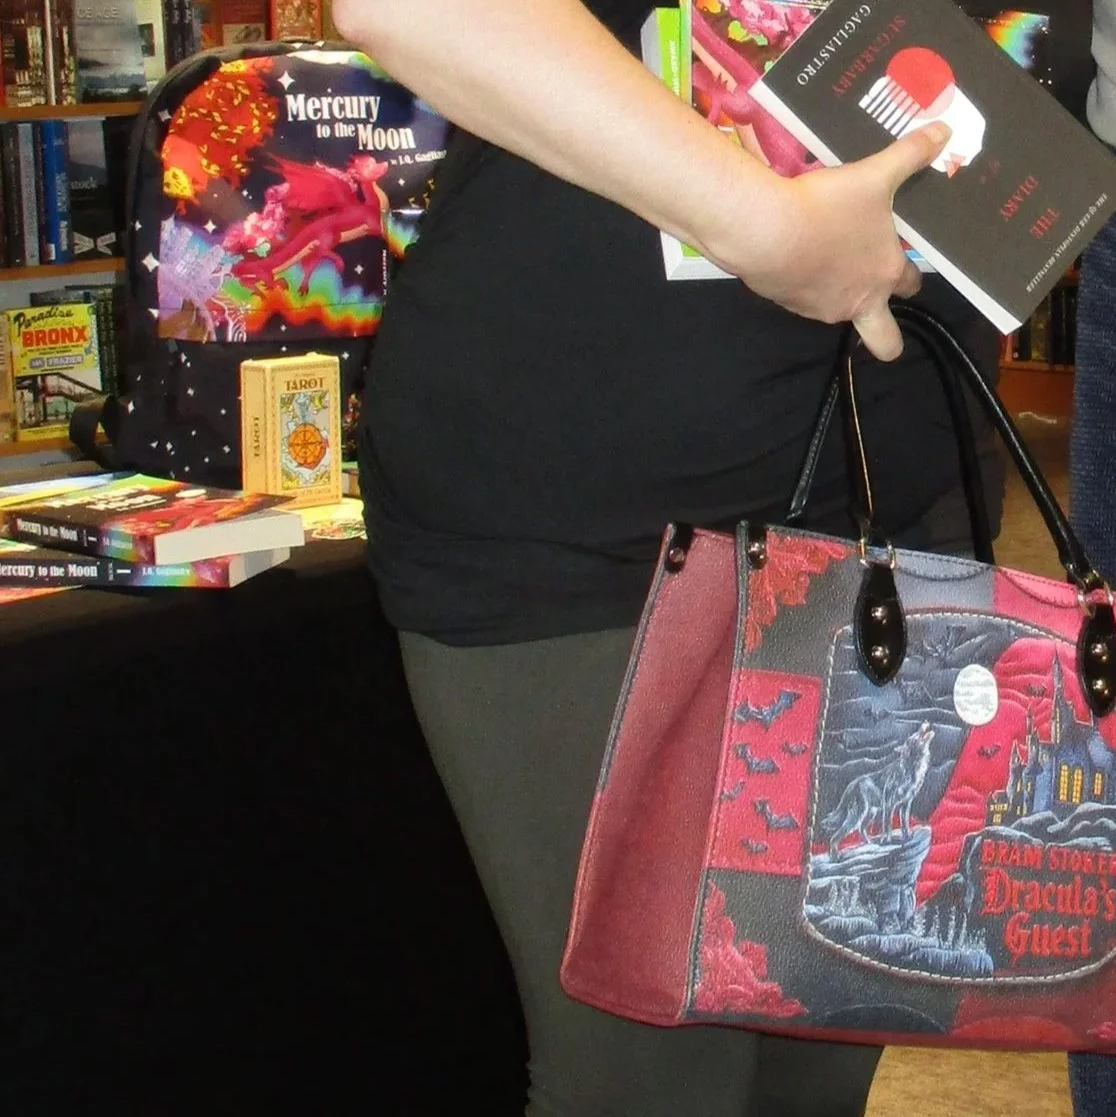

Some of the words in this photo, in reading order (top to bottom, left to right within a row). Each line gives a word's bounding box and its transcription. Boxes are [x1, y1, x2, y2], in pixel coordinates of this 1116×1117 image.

[797, 5, 871, 86] GAGLIASTRO
[832, 14, 907, 95] SUGARBABY
[285, 94, 380, 122] Mercury
[316, 123, 331, 139] to
[334, 122, 356, 138] the
[357, 124, 417, 151] Moon
[1000, 174, 1039, 222] DIARY
[1029, 207, 1060, 238] THE
[22, 325, 88, 348] BRONX
[284, 376, 325, 391] TAROT
[0, 563, 36, 578] ercury
[38, 565, 48, 577] to
[50, 564, 65, 577] the
[68, 563, 98, 577] Moon
[982, 838, 1042, 870] BRAM
[980, 867, 1116, 921] Dracula's
[1003, 912, 1092, 964] Guest
